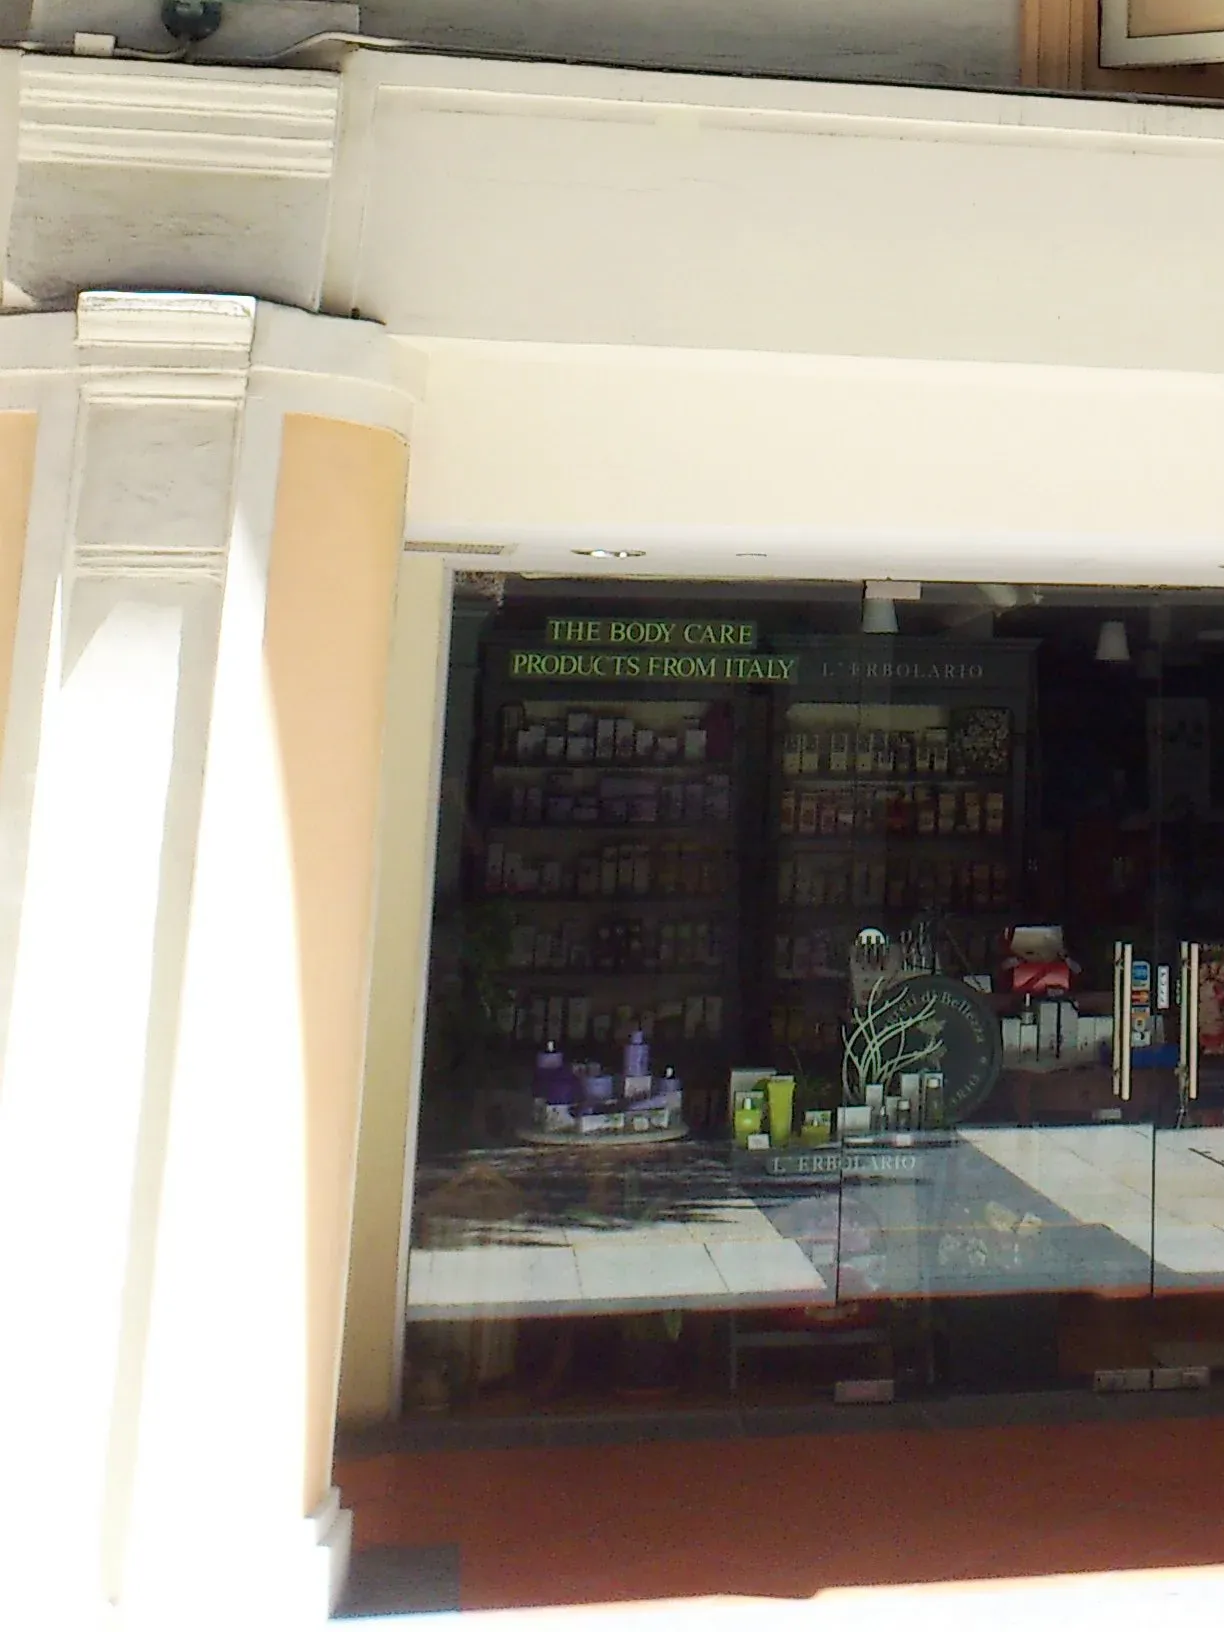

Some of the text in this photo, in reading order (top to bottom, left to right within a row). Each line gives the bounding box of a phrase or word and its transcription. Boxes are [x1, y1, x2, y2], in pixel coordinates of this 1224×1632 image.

[551, 619, 753, 645] THE BODY CARE
[512, 653, 795, 680] PRODUCTS FROM ITALY
